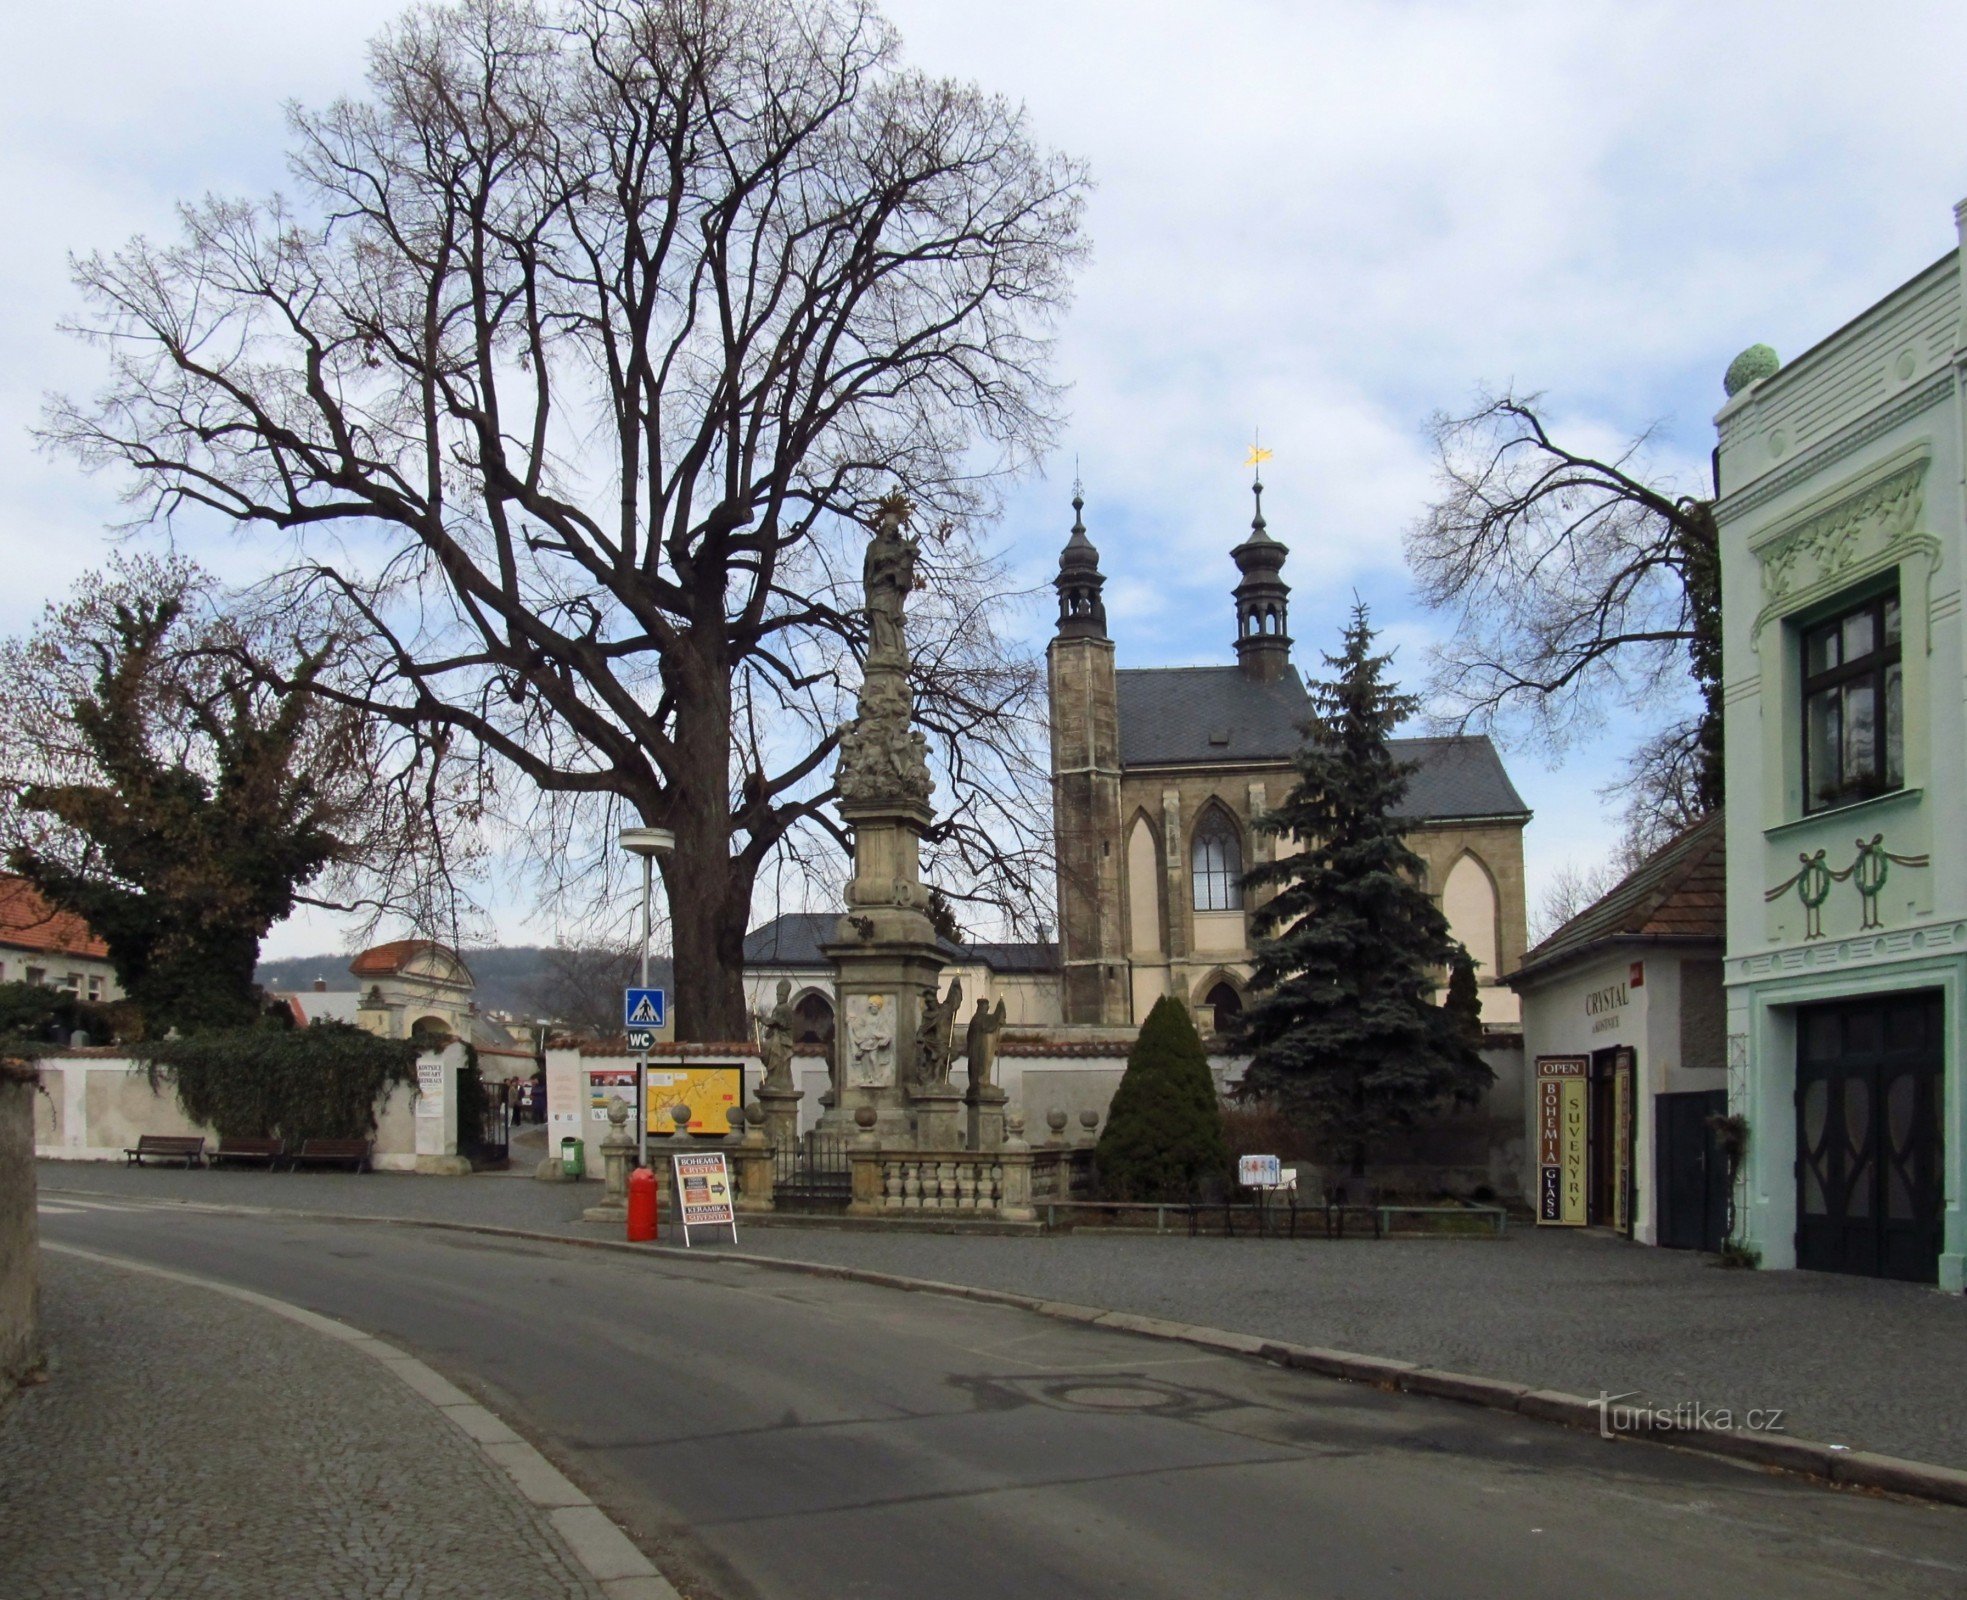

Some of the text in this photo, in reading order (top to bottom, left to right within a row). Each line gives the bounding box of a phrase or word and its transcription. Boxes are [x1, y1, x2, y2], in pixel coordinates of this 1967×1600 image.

[1586, 982, 1629, 1016] CRYSTAL
[630, 1033, 650, 1047] WC
[1543, 1063, 1579, 1074] OPEN
[1544, 1083, 1558, 1217] BOHEMIA GLASS
[681, 1157, 720, 1166] BOHEMIA
[683, 1166, 719, 1174] CRYSTAL
[687, 1205, 727, 1213] KERAMIKA
